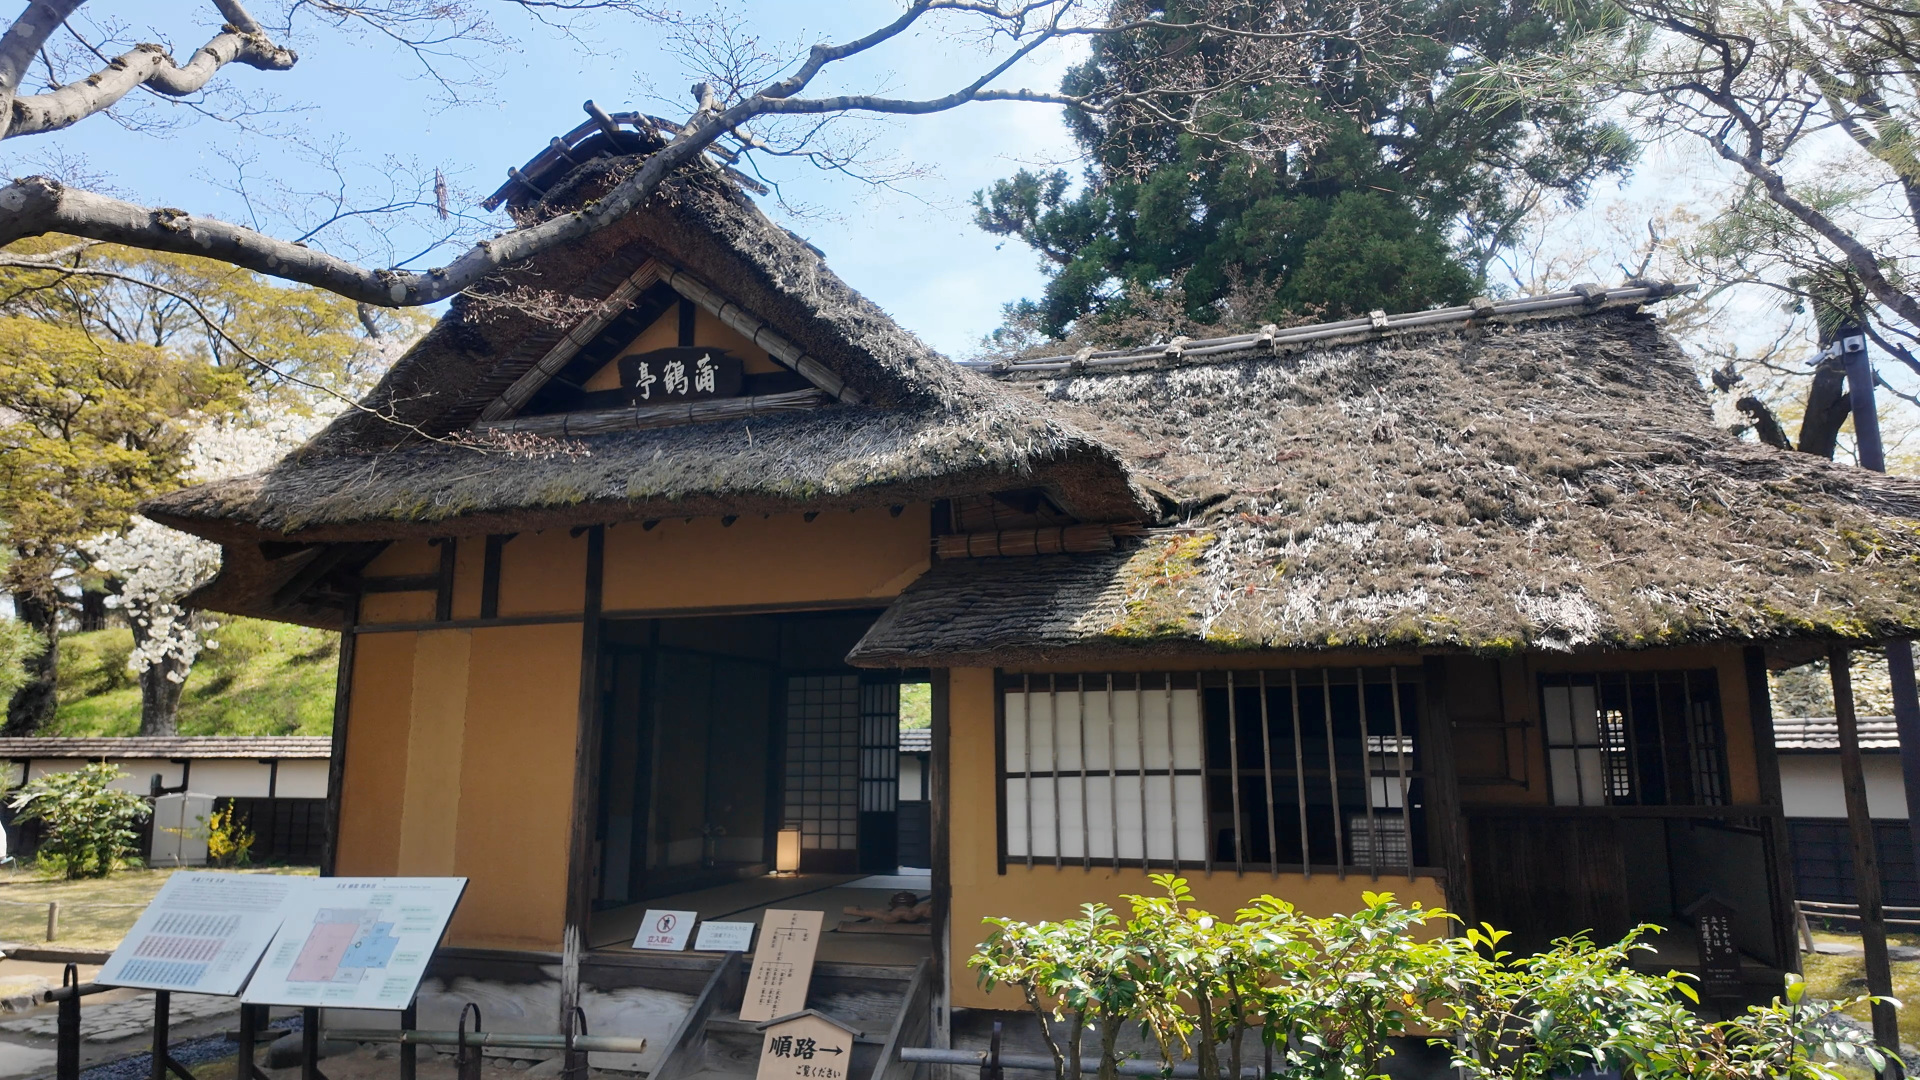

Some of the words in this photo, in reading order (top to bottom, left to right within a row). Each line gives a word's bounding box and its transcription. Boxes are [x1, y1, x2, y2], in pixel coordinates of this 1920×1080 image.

[646, 935, 675, 944] 立入禁止
[1700, 916, 1714, 962] ご遠慮下さい
[1710, 915, 1722, 946] 立入りは
[1720, 916, 1733, 954] ここからの
[768, 1035, 818, 1060] 順路
[795, 1064, 841, 1079] ご覧ください
